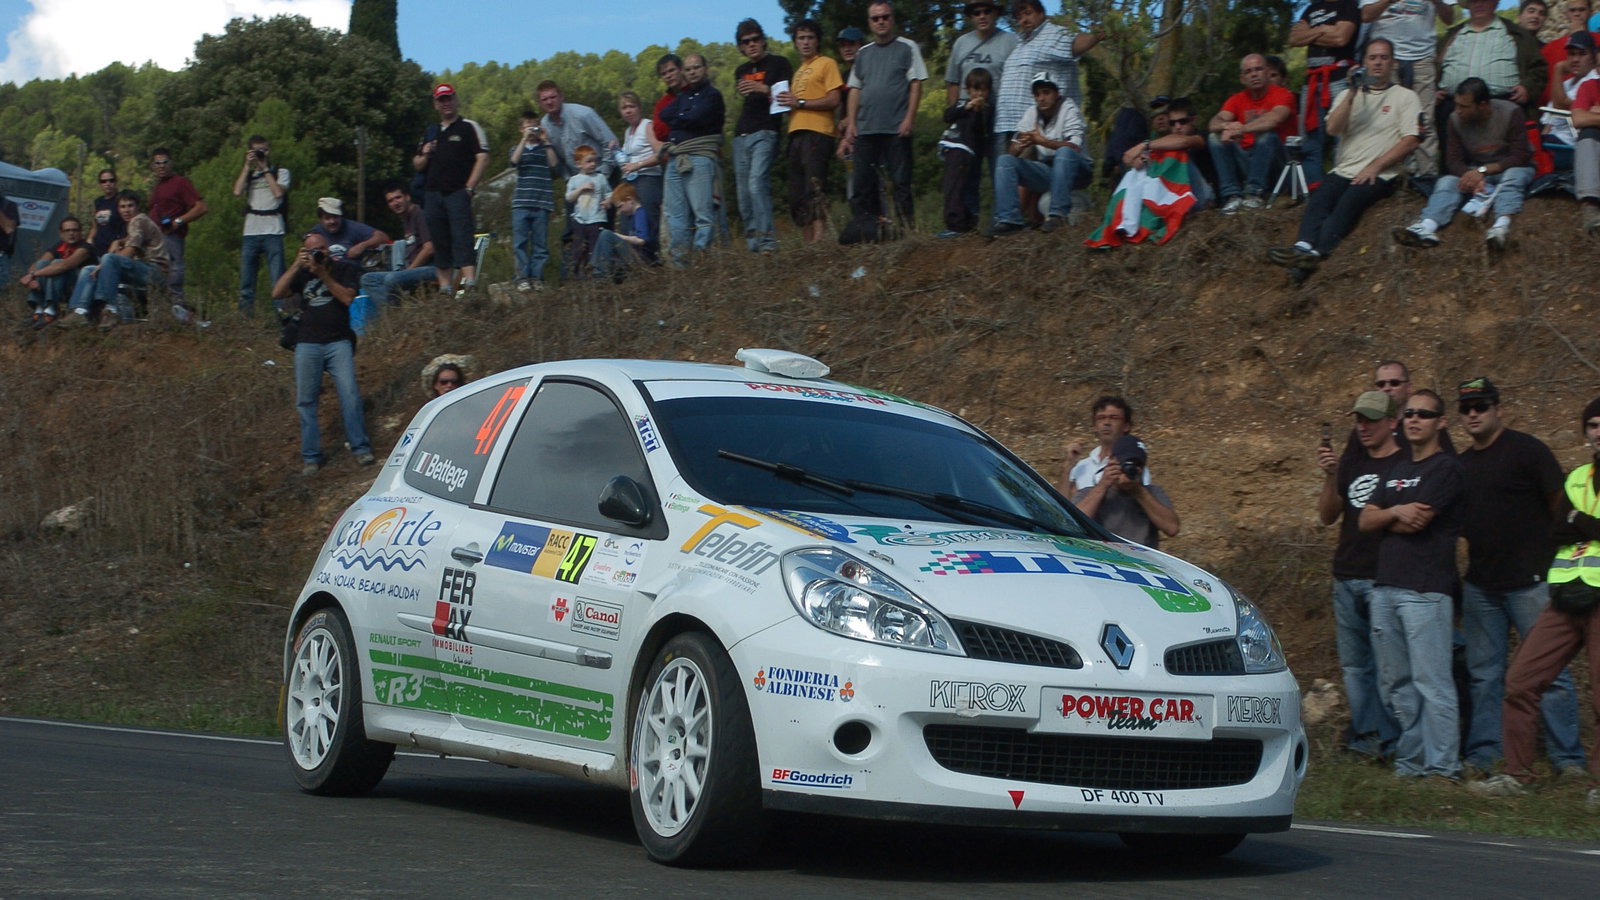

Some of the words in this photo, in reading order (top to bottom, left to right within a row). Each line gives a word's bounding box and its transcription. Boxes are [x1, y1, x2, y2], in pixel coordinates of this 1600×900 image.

[744, 382, 833, 397] POWER
[837, 392, 887, 406] CAR
[474, 386, 527, 455] 47
[639, 420, 660, 453] TRT
[425, 454, 469, 492] Bettega
[508, 542, 542, 557] movistar
[547, 534, 570, 549] RACC
[680, 504, 780, 576] Telefin
[560, 535, 598, 582] 47
[989, 552, 1171, 589] TRT
[316, 571, 331, 585] FOR
[334, 575, 356, 591] YOUR
[358, 578, 386, 594] BEACH
[387, 584, 421, 602] HOLIDAY
[439, 566, 477, 606] FER
[585, 606, 619, 624] Canol
[369, 632, 397, 646] RENAULT
[397, 637, 423, 648] SPORT
[432, 638, 473, 655] IMMOBILIARE
[387, 674, 426, 705] R3
[768, 666, 839, 688] FONDERIA
[766, 681, 836, 702] ALBINESE
[1061, 694, 1144, 720] POWER
[1149, 698, 1196, 722] CAR
[1107, 710, 1160, 731] team
[1227, 695, 1282, 725] KEROX
[772, 768, 853, 785] BFGoodrich
[1080, 789, 1104, 802] DF
[1110, 790, 1140, 804] 400
[1142, 792, 1164, 806] TV
